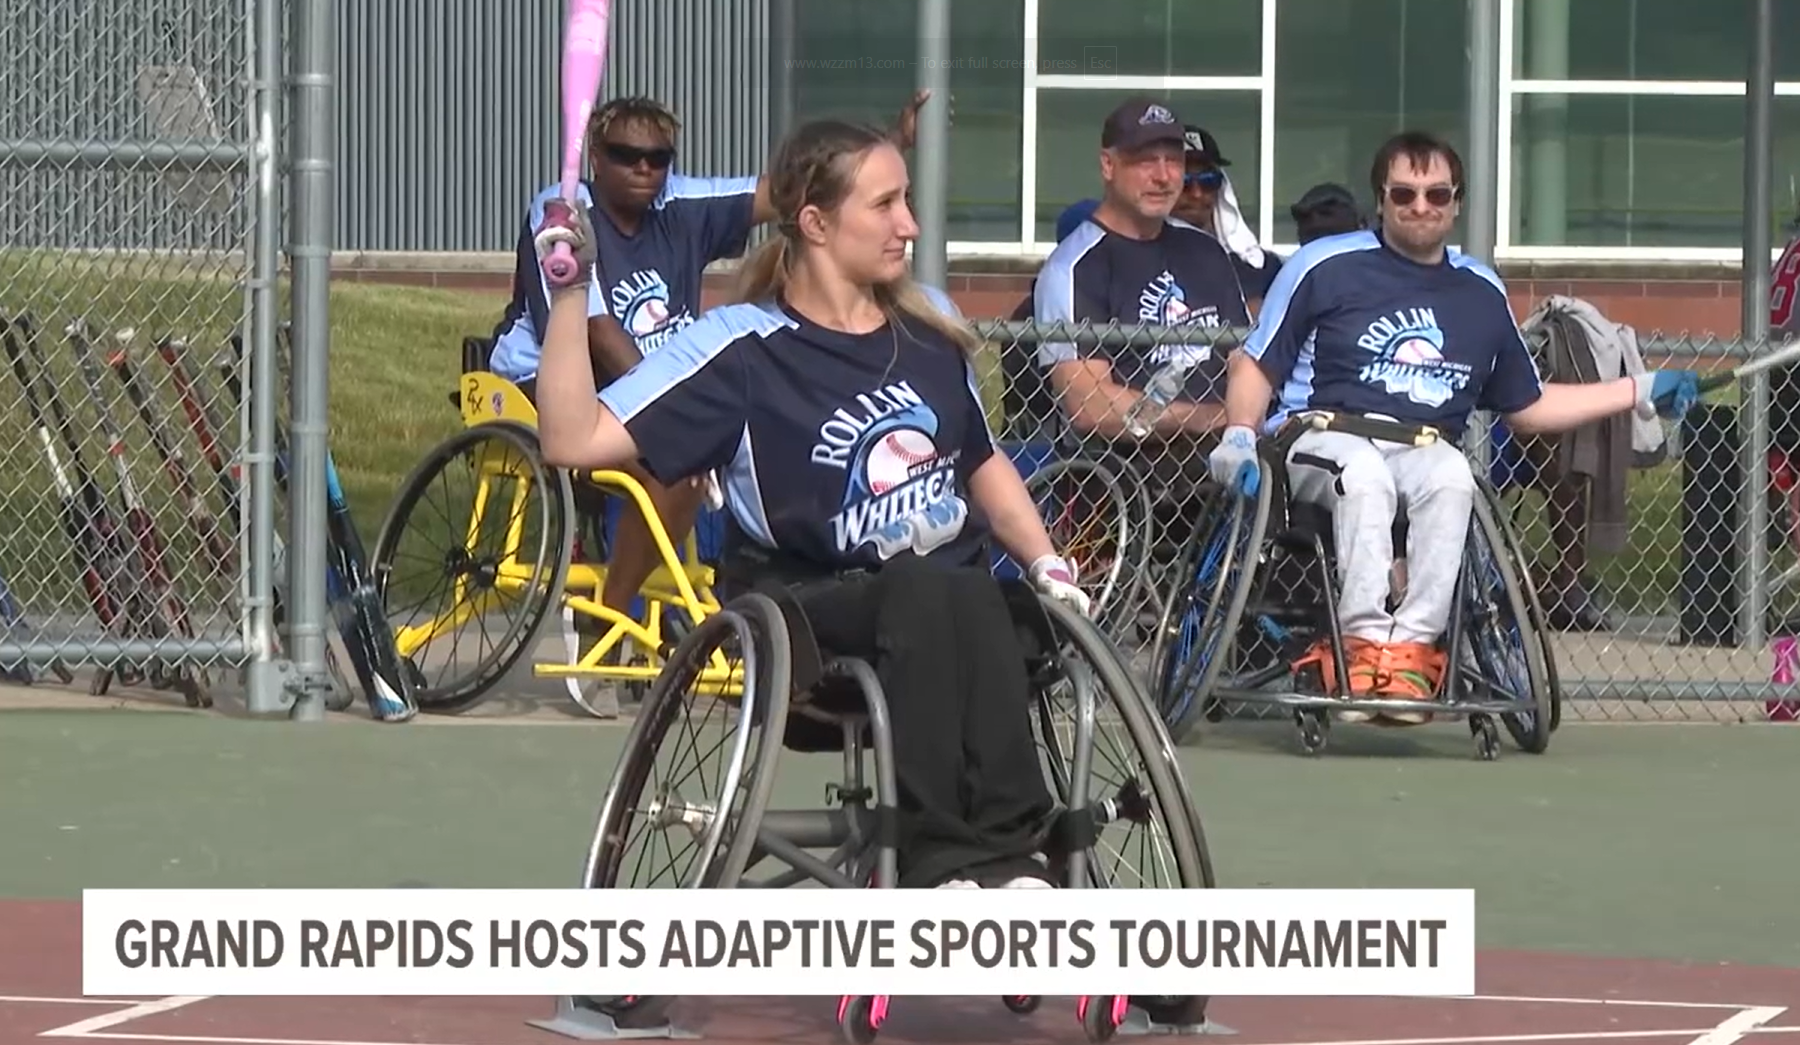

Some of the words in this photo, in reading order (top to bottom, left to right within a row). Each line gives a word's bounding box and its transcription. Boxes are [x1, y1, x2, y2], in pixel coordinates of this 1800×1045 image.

[1357, 308, 1437, 353] ROLLIN
[811, 380, 923, 469] ROLLIN
[908, 460, 935, 477] WEST
